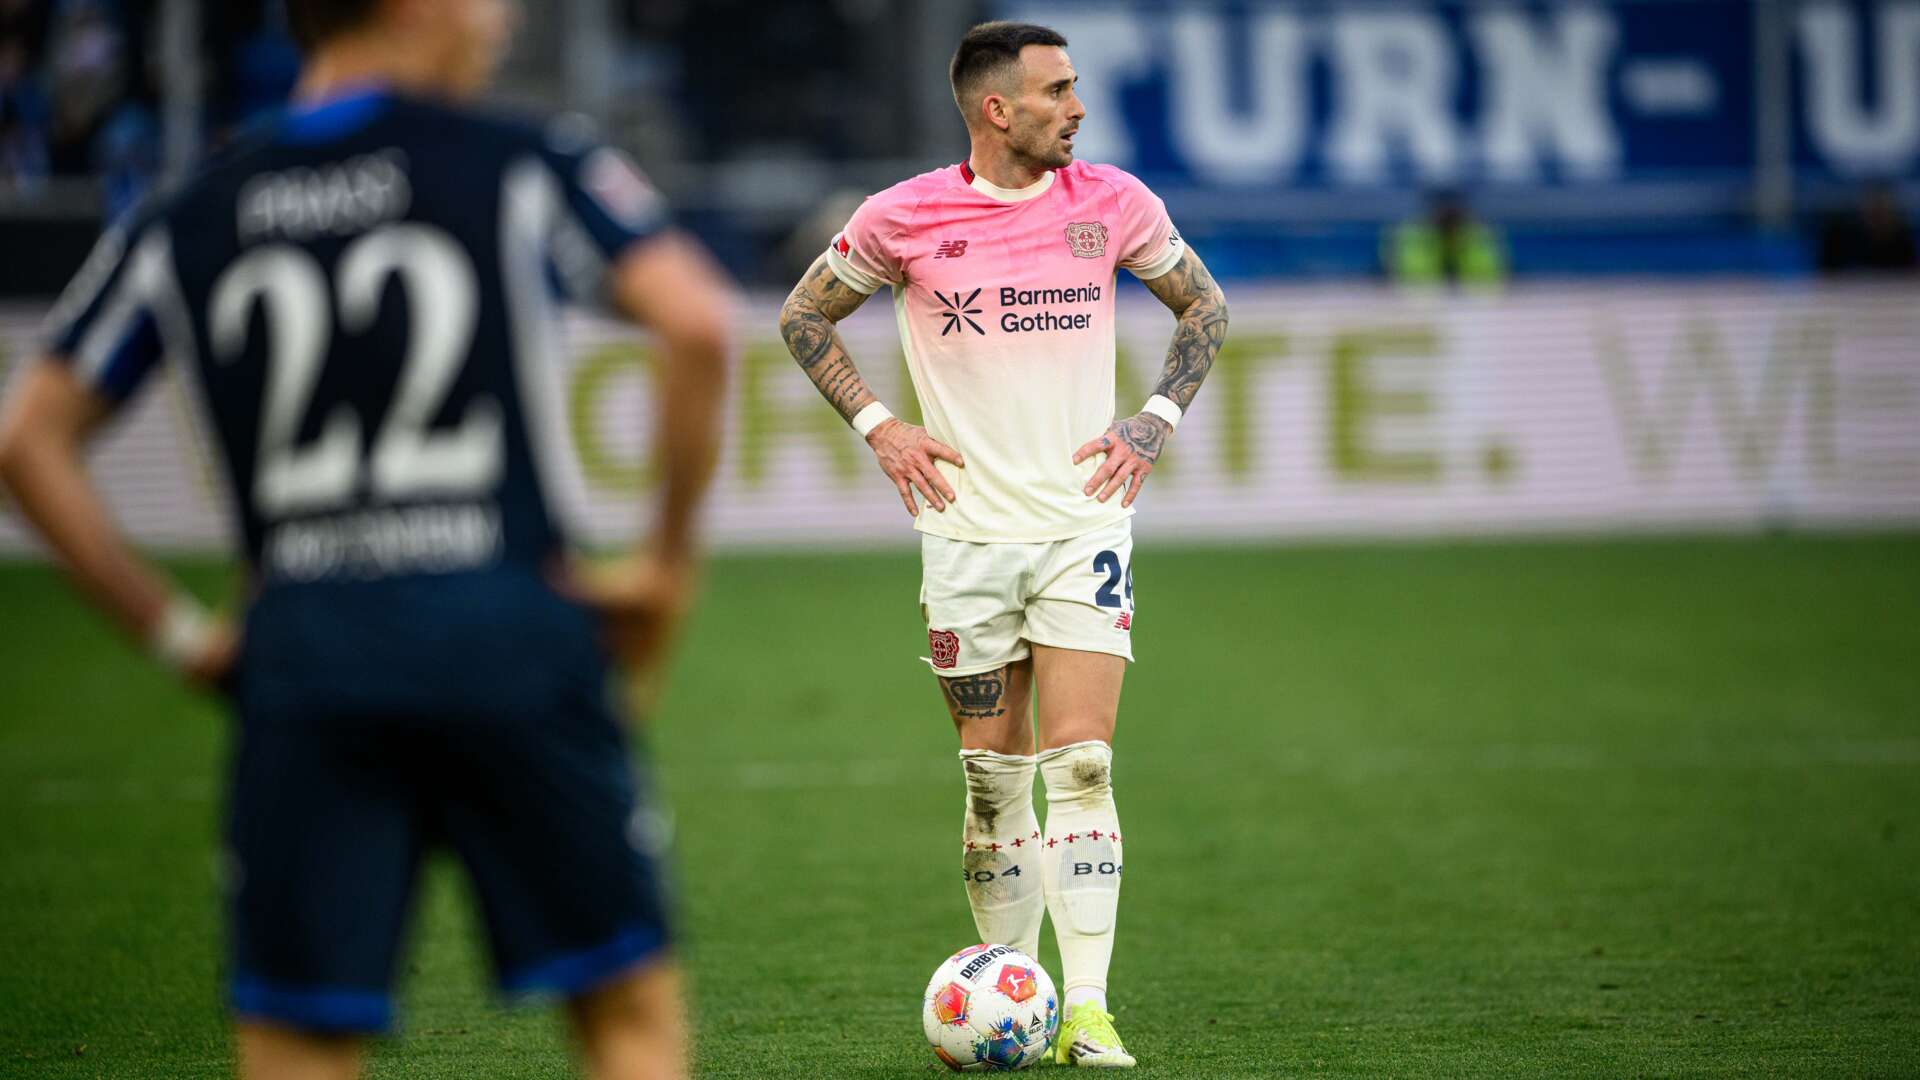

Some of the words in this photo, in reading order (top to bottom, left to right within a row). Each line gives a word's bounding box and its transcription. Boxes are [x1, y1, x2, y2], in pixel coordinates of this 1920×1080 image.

[1000, 282, 1101, 306] Barmenia
[1001, 311, 1092, 333] Gothaer
[208, 222, 502, 514] 22
